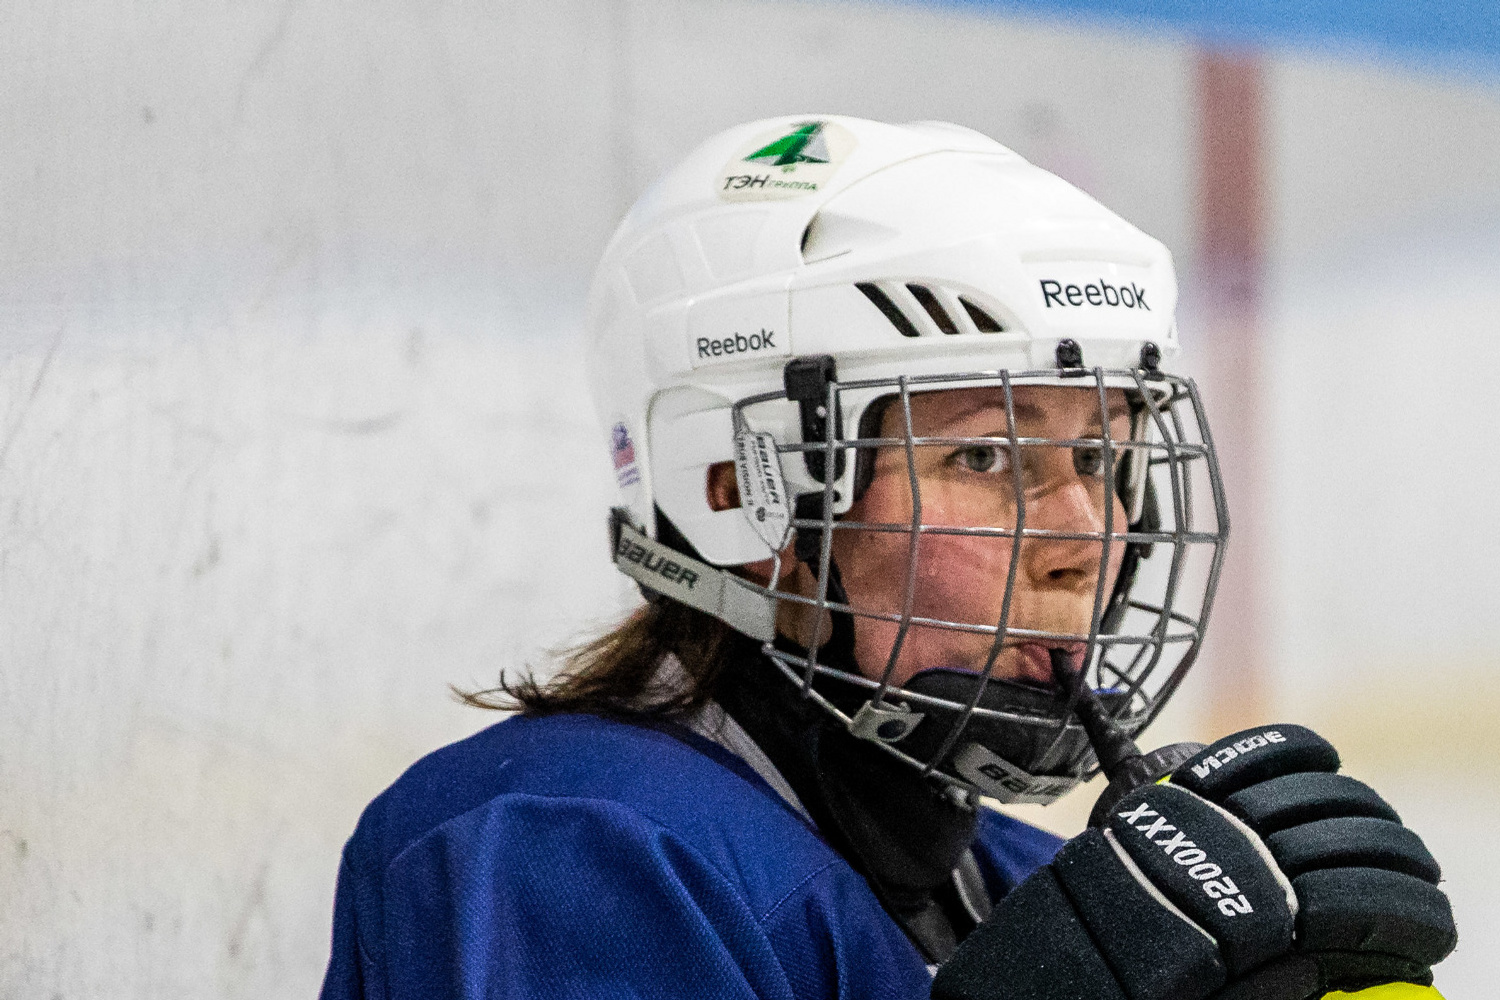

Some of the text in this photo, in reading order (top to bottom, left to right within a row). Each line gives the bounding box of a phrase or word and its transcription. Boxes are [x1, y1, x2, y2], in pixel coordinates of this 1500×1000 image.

[723, 174, 771, 190] ТЭН
[1039, 278, 1152, 312] Reebok
[697, 328, 776, 359] Reebok
[1118, 802, 1254, 917] 2200XXX
